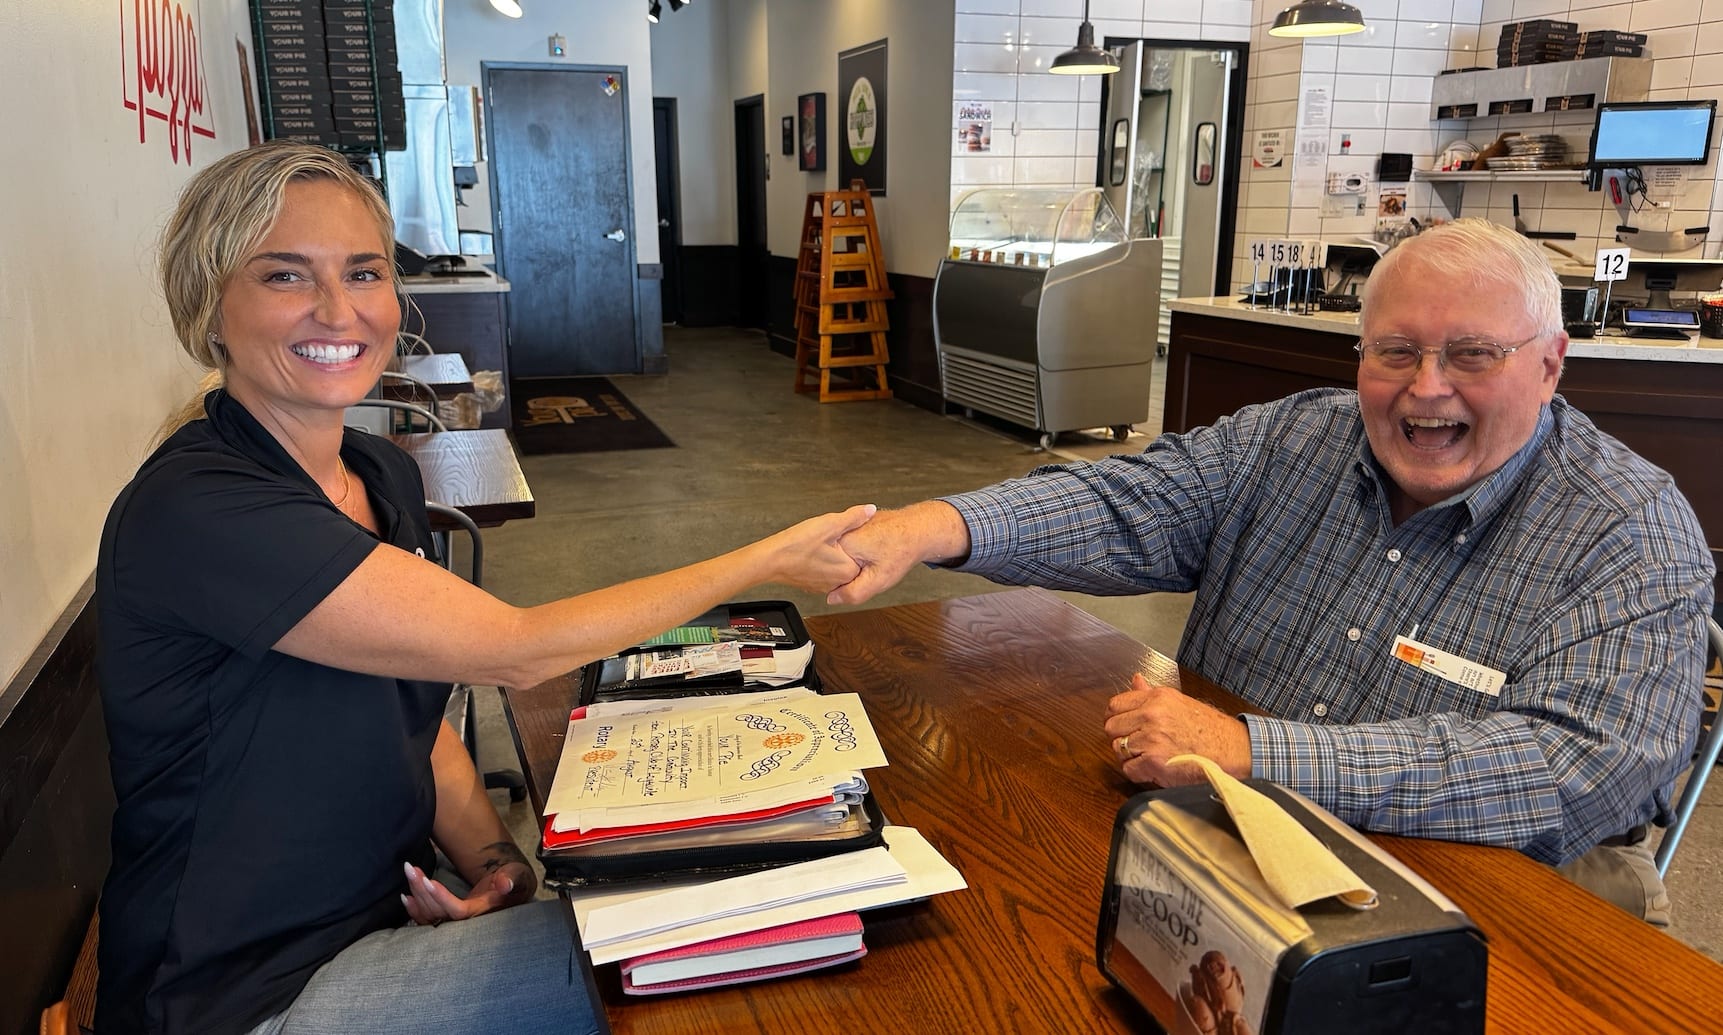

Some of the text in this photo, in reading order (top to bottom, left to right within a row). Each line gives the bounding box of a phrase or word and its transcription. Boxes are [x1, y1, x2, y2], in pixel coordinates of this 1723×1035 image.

[278, 80, 297, 88] YOUR
[280, 108, 299, 116] YOUR
[1252, 244, 1264, 261] 14
[1272, 244, 1284, 262] 15
[1288, 245, 1299, 262] 18
[1602, 254, 1624, 275] 12
[592, 726, 613, 748] Rotary
[1128, 872, 1198, 947] SCOOP
[1180, 882, 1203, 927] THE
